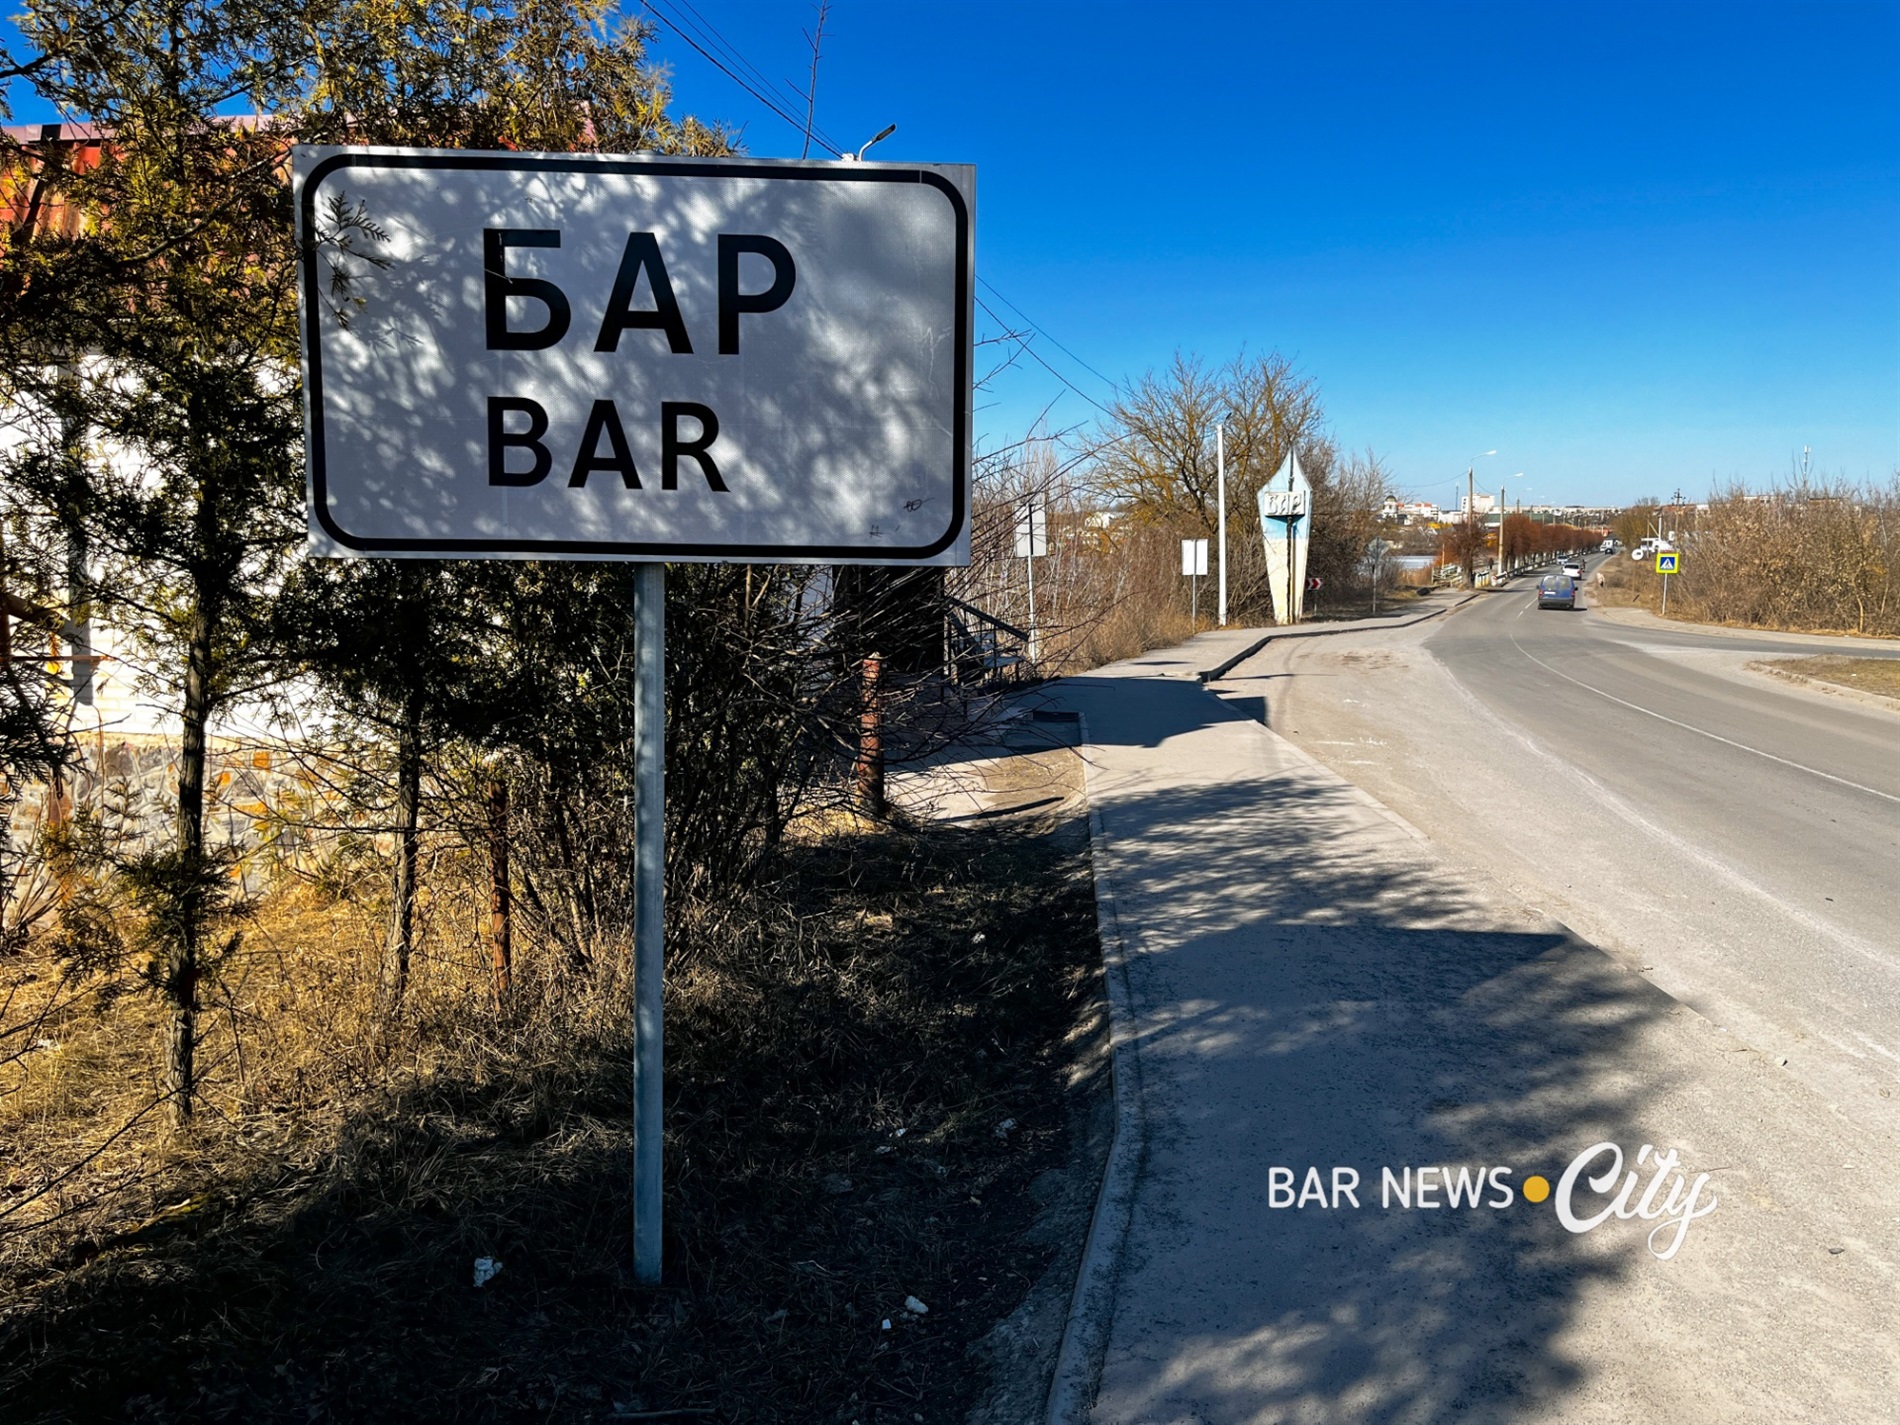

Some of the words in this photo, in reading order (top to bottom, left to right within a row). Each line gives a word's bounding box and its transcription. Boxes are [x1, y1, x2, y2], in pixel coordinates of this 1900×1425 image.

[483, 228, 796, 355] БАР
[488, 396, 730, 492] BAR
[1267, 494, 1302, 514] БАР
